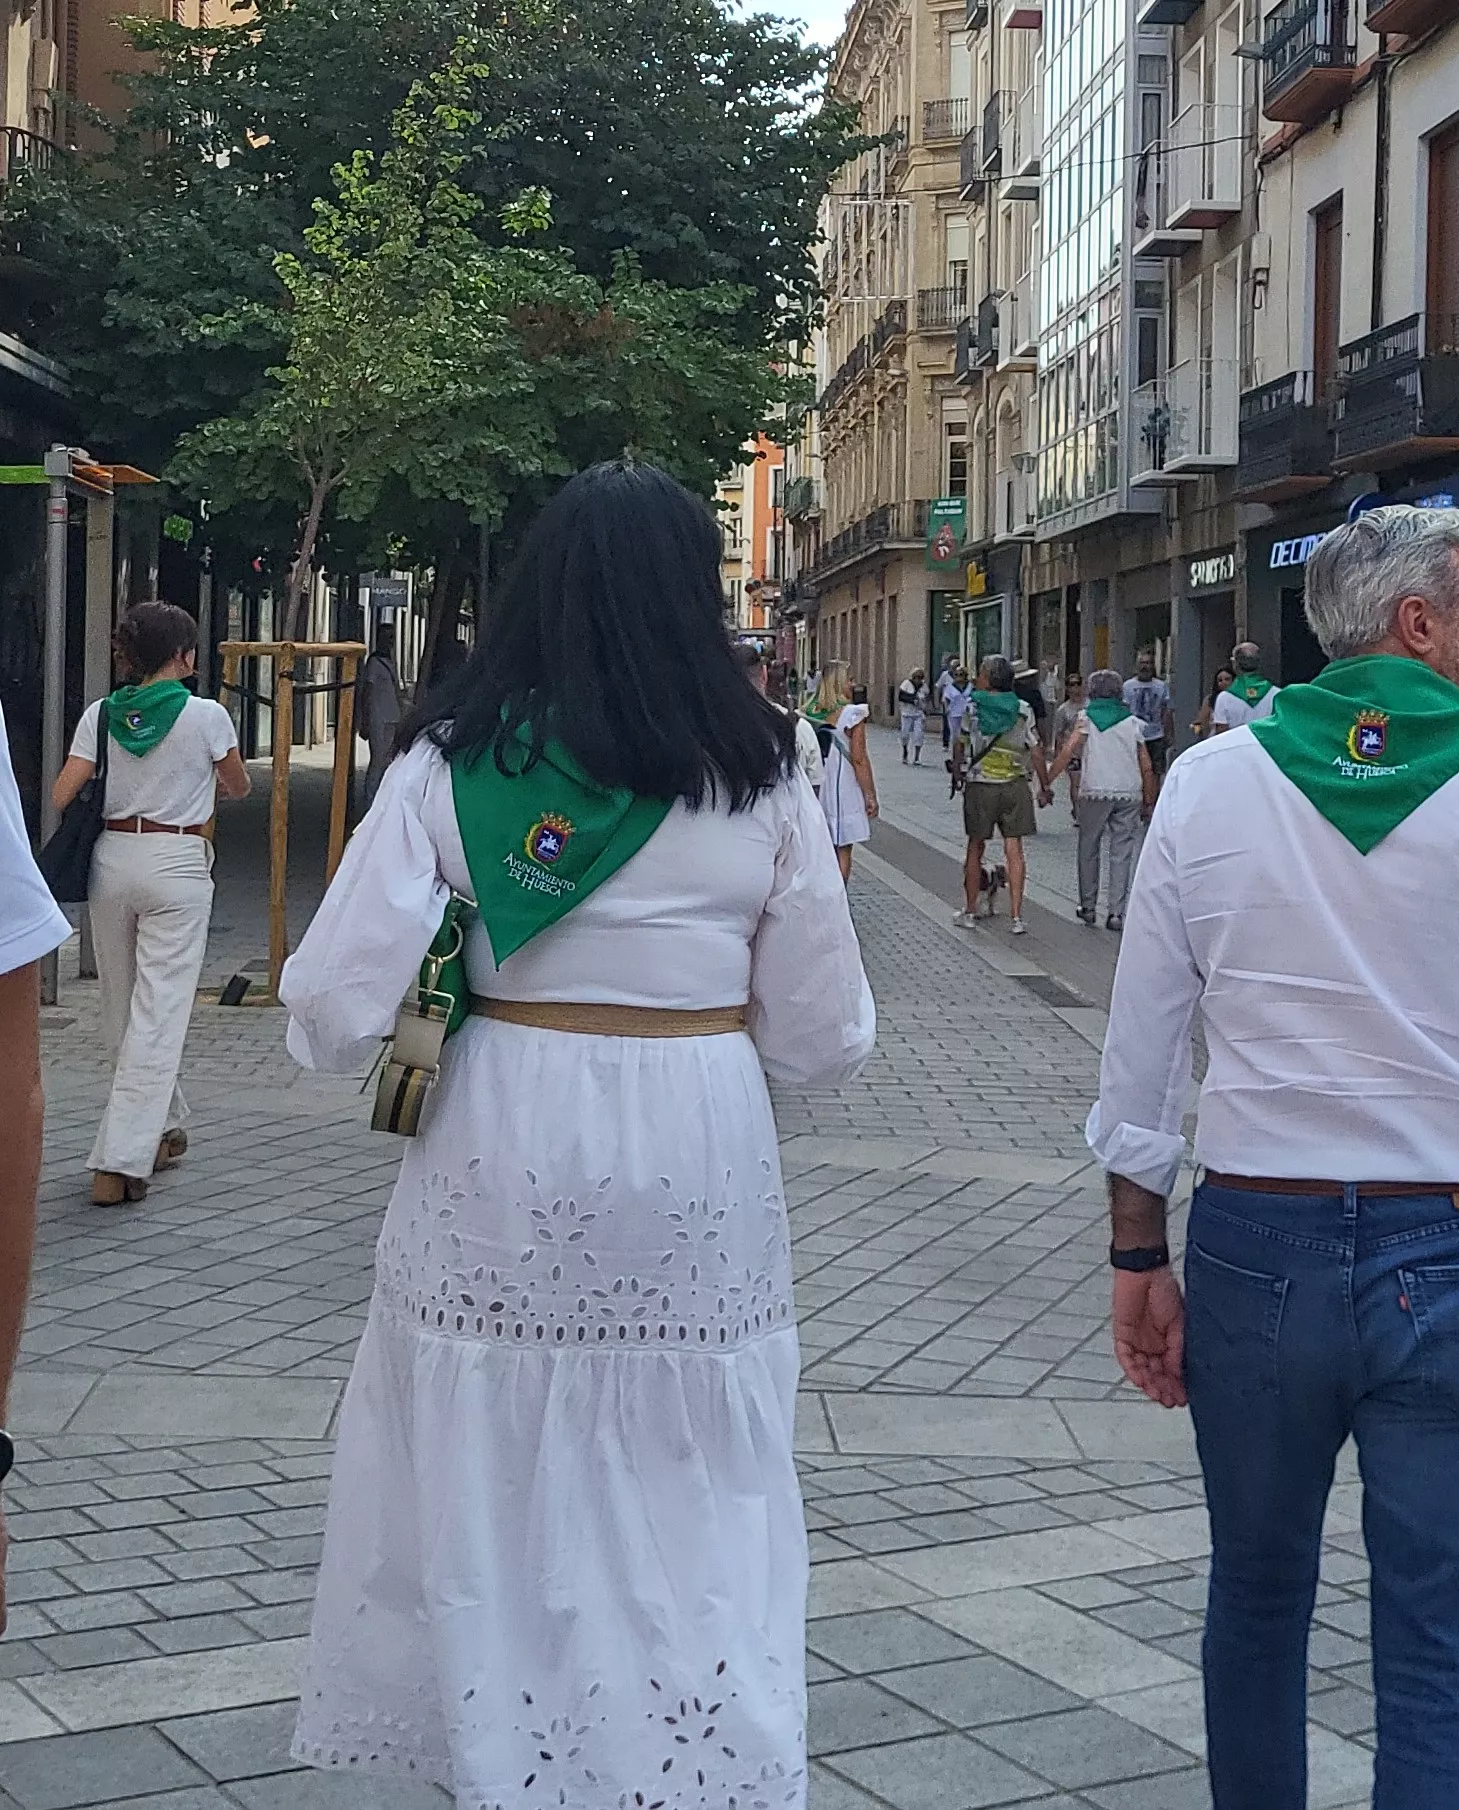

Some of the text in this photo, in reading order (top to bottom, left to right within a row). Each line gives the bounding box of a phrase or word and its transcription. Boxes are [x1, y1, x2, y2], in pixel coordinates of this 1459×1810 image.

[503, 852, 576, 891] AYUNTAMIENTO
[508, 867, 561, 897] DE HUESCA
